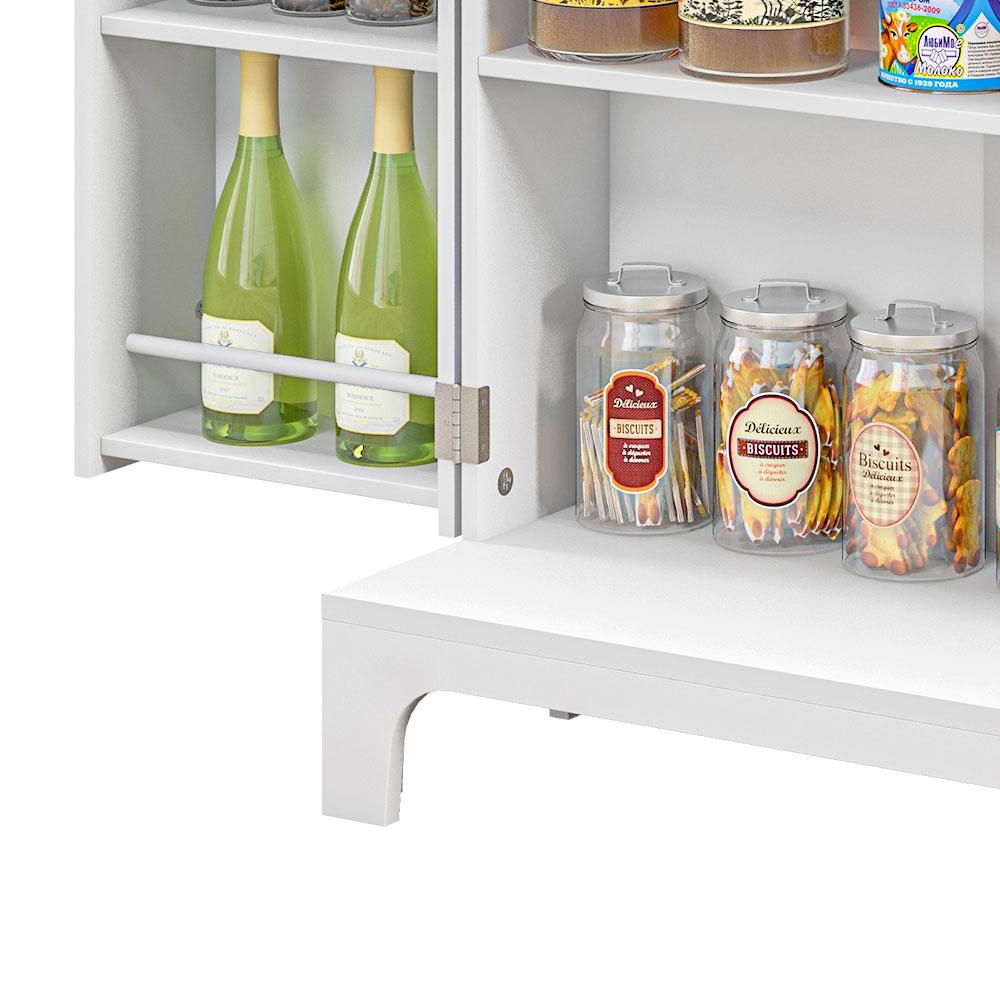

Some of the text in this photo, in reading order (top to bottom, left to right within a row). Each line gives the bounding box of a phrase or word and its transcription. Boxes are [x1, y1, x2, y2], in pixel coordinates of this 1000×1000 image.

[613, 398, 658, 409] Délicieux
[616, 424, 654, 434] BISCUITS
[744, 421, 802, 434] Délicieux
[747, 443, 799, 456] BISCUITS
[859, 452, 912, 471] Biscuits
[863, 469, 904, 482] Délicieux
